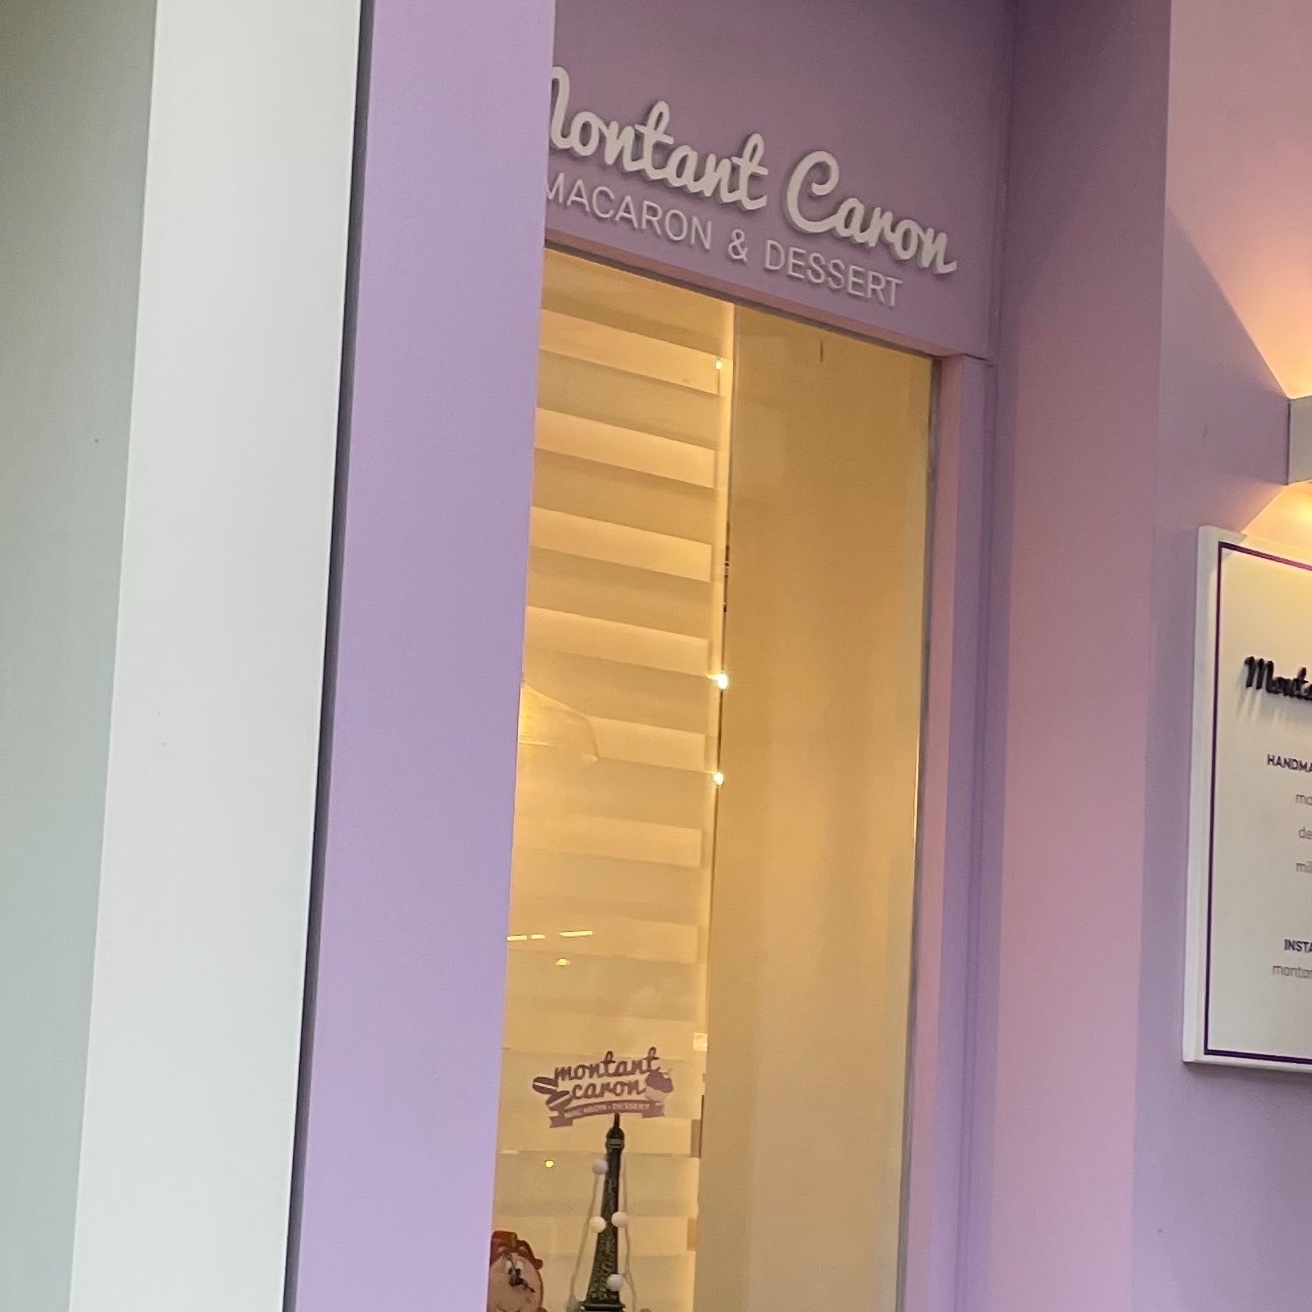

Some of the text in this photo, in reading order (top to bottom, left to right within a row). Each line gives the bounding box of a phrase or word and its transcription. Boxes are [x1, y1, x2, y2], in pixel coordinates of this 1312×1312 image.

[787, 150, 957, 274] Caron
[728, 228, 749, 264] &
[765, 239, 902, 308] DESSERT
[555, 1046, 661, 1081] montant
[571, 1078, 647, 1100] caron
